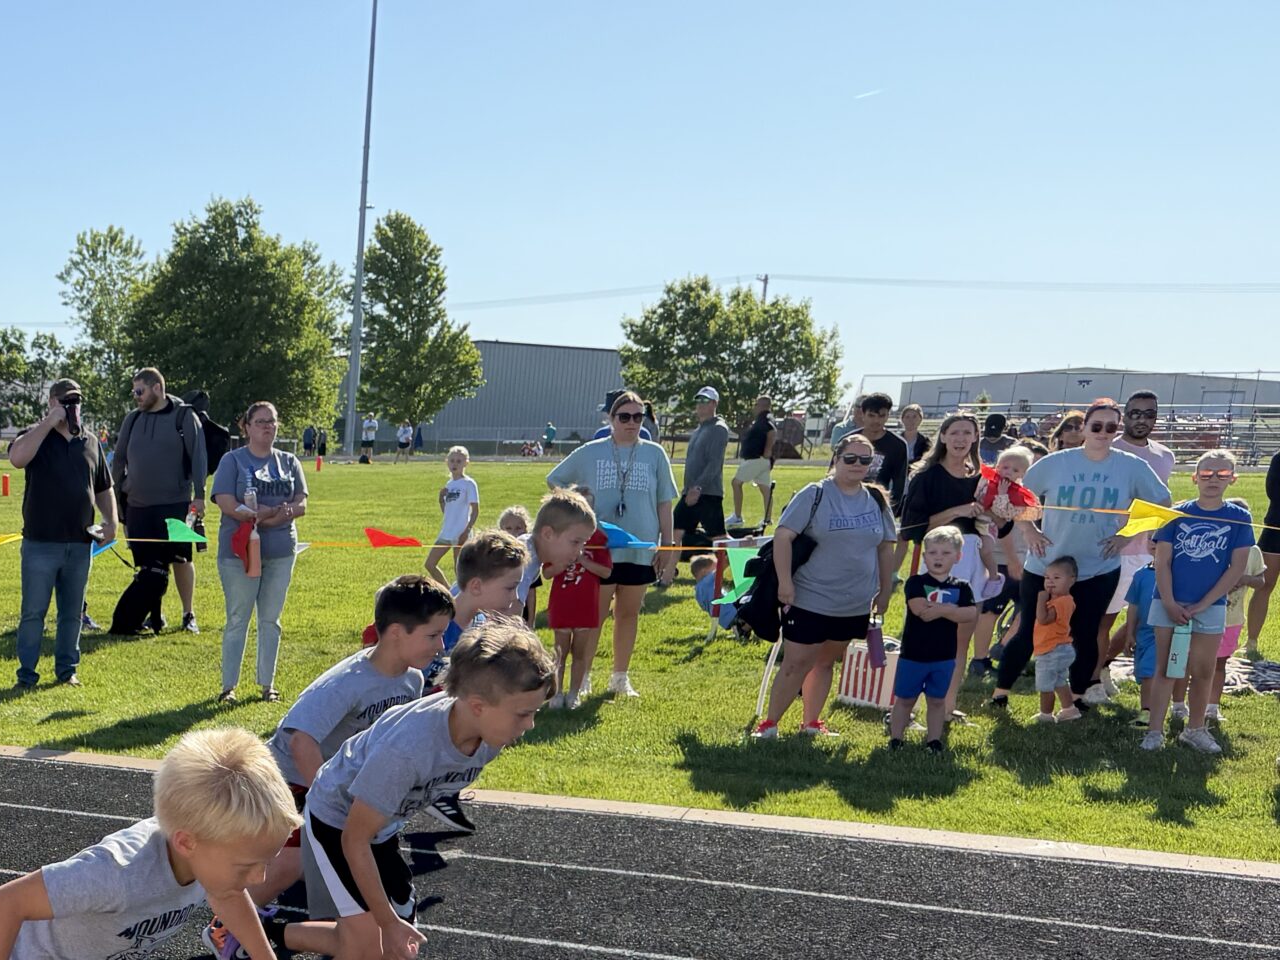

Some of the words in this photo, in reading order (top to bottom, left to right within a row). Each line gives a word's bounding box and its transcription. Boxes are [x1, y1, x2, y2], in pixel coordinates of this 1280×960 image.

[620, 460, 650, 470] MDDIE
[1072, 472, 1085, 482] IN
[1092, 472, 1109, 483] MY
[1056, 485, 1119, 509] MOM
[829, 512, 878, 529] FOOTBALL
[1174, 531, 1228, 551] Softball
